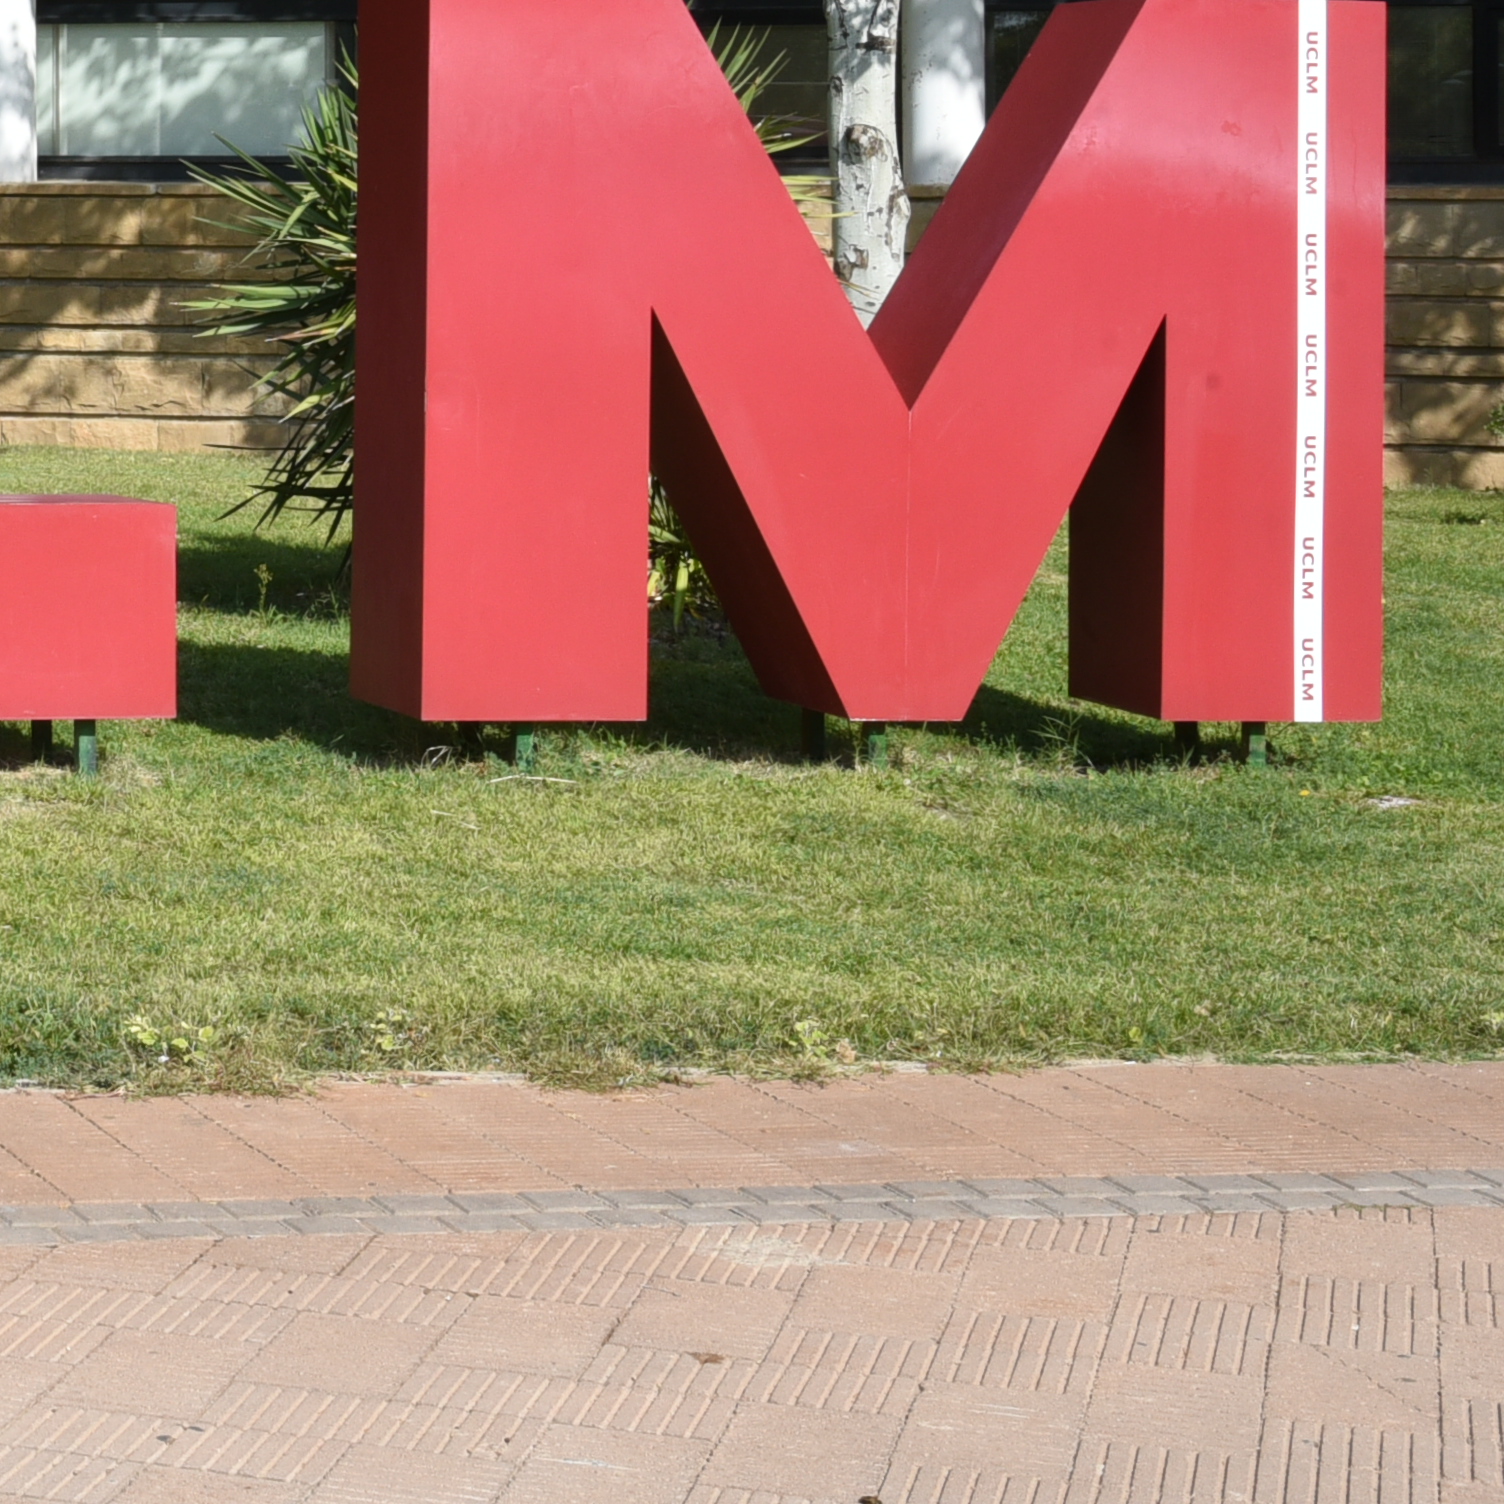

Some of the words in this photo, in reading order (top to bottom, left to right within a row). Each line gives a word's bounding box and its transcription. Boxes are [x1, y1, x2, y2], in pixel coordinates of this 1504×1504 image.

[1306, 31, 1320, 94] UCLM
[1305, 132, 1319, 195] UCLM
[1305, 233, 1319, 296] UCLM
[1304, 334, 1318, 397] UCLM
[1303, 435, 1317, 498] UCLM
[1302, 536, 1316, 600] UCLM
[1301, 638, 1315, 701] UCLM
